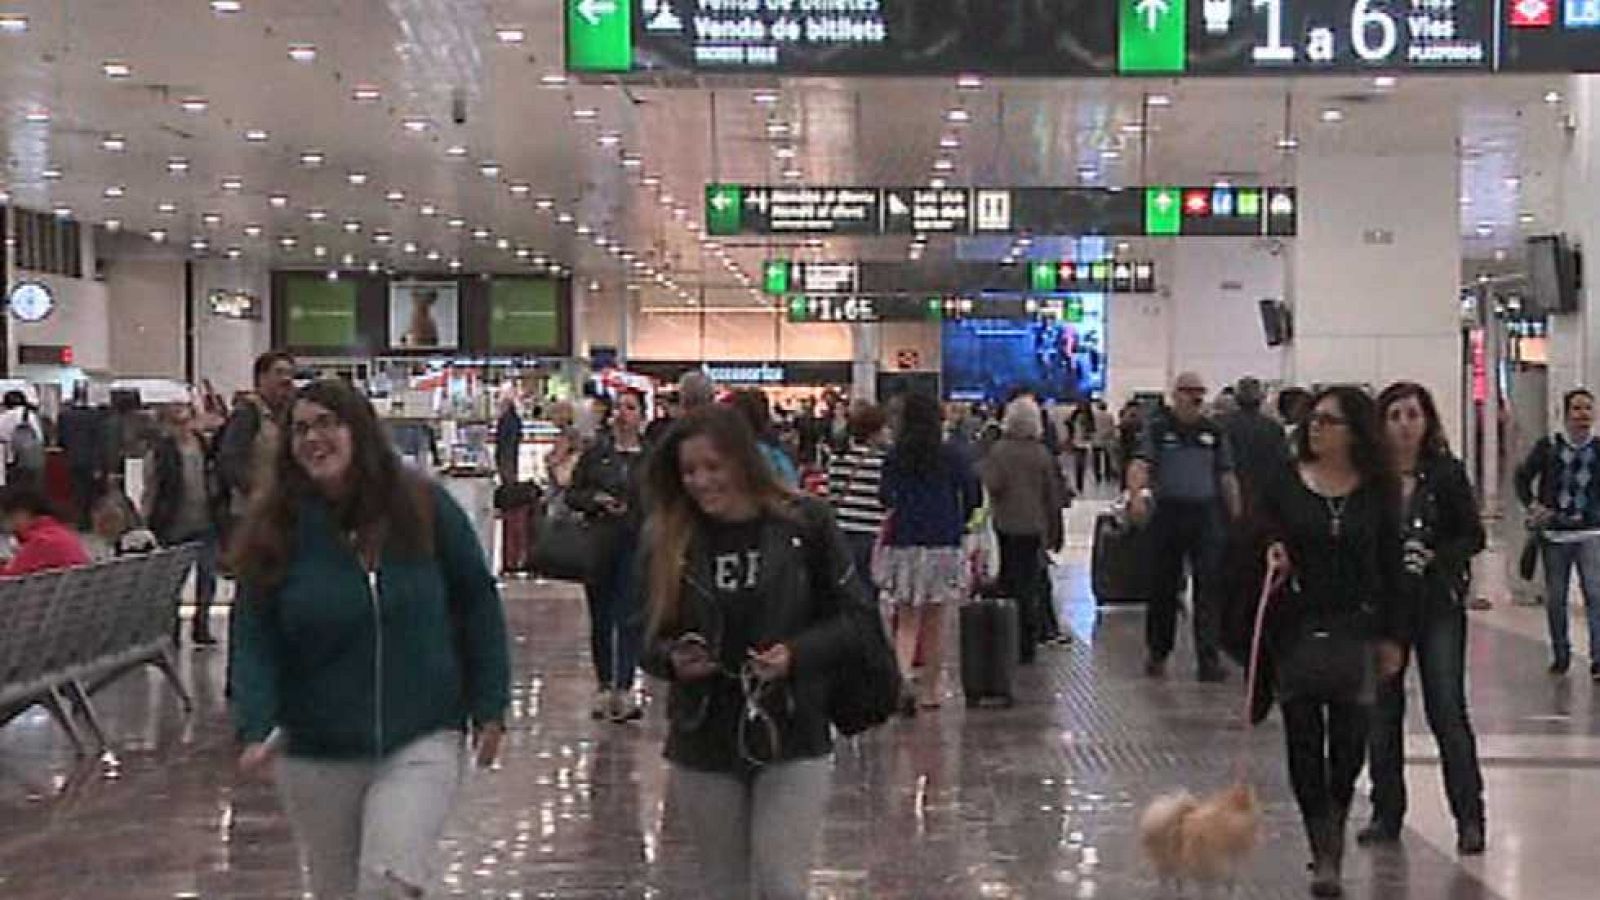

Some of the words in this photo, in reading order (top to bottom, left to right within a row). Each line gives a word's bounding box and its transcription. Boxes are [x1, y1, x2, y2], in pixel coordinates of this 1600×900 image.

[693, 16, 765, 40] Venda
[770, 17, 801, 41] de
[806, 17, 886, 42] bitllets
[1252, 0, 1295, 60] 1
[1306, 28, 1334, 61] a
[1350, 0, 1397, 61] 6
